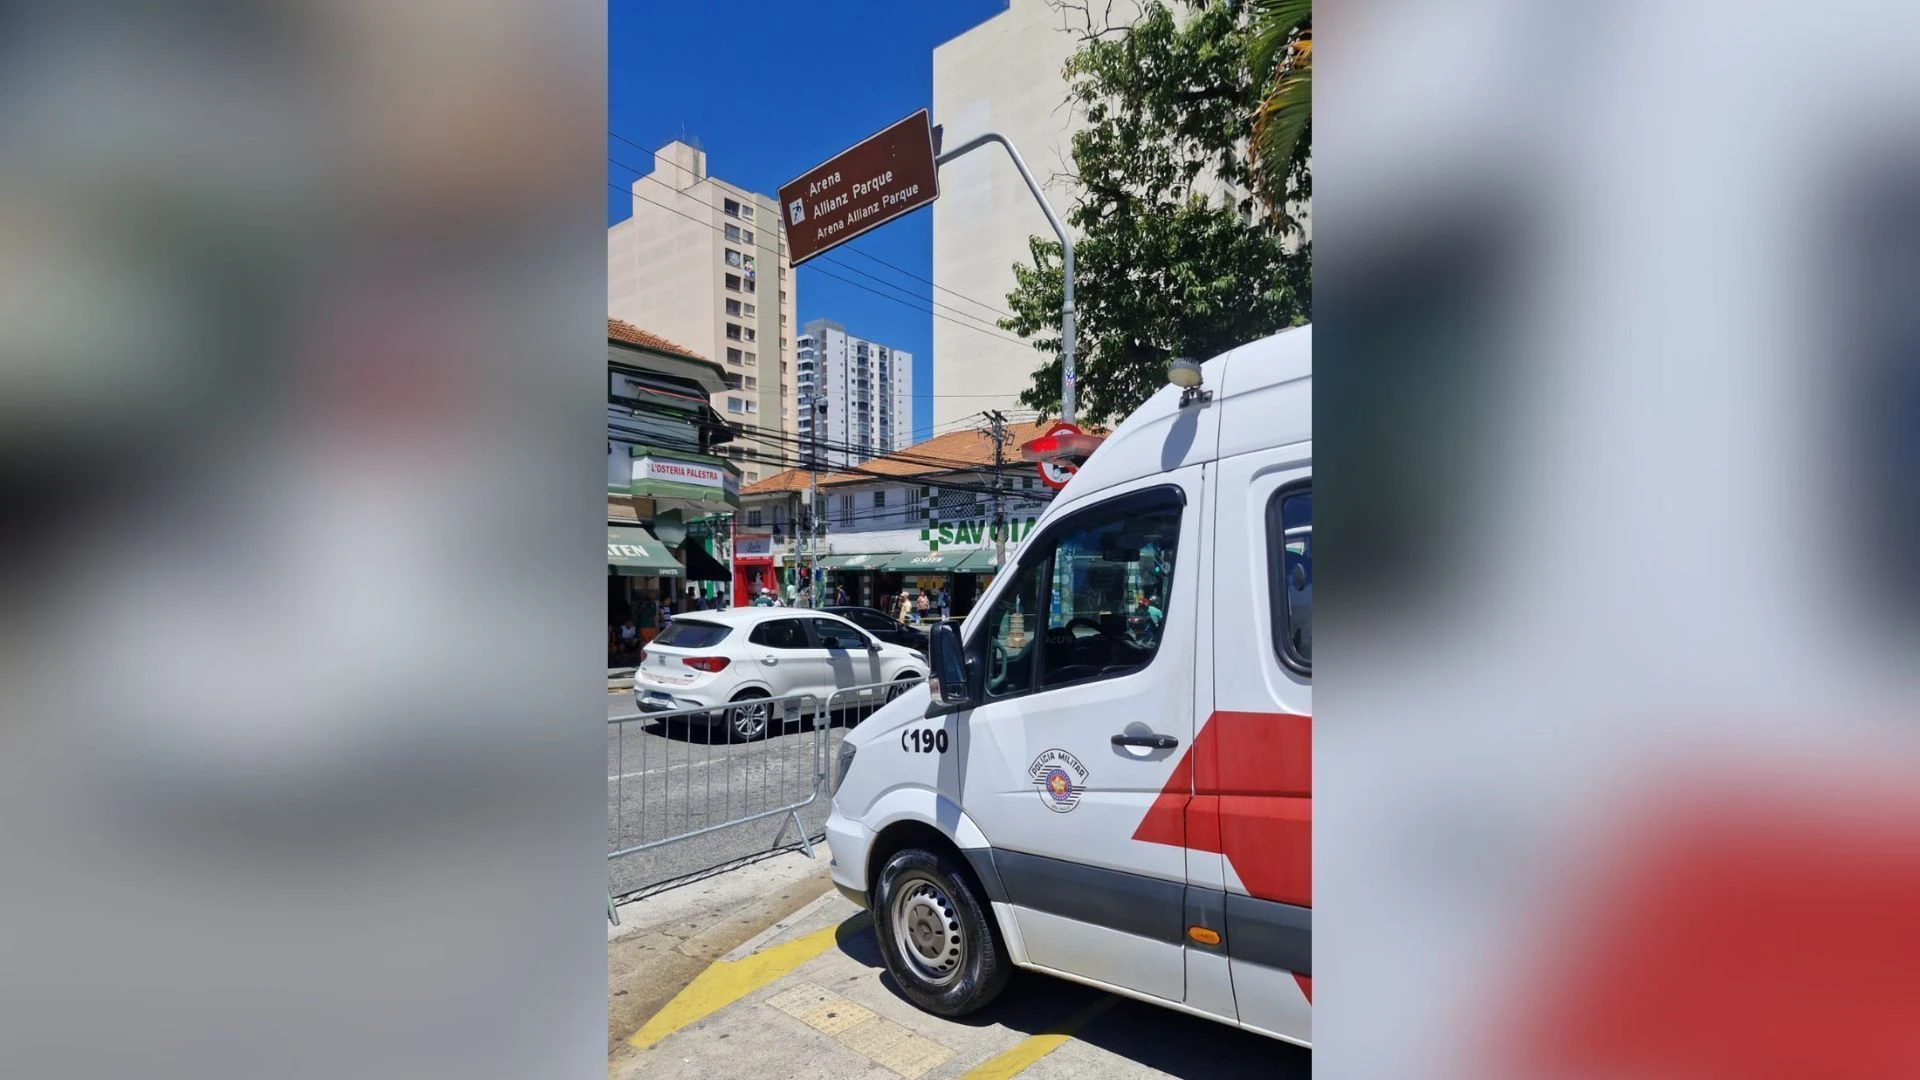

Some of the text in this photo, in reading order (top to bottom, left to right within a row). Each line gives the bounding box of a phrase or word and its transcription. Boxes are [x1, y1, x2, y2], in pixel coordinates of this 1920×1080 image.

[809, 171, 841, 197] Arena
[813, 170, 893, 219] Allianz Parque
[817, 183, 919, 240] Arena Allianz Parque
[651, 463, 718, 480] L'OSTERIA PALESTRA
[910, 728, 949, 753] 190
[1058, 751, 1085, 778] MILITAR
